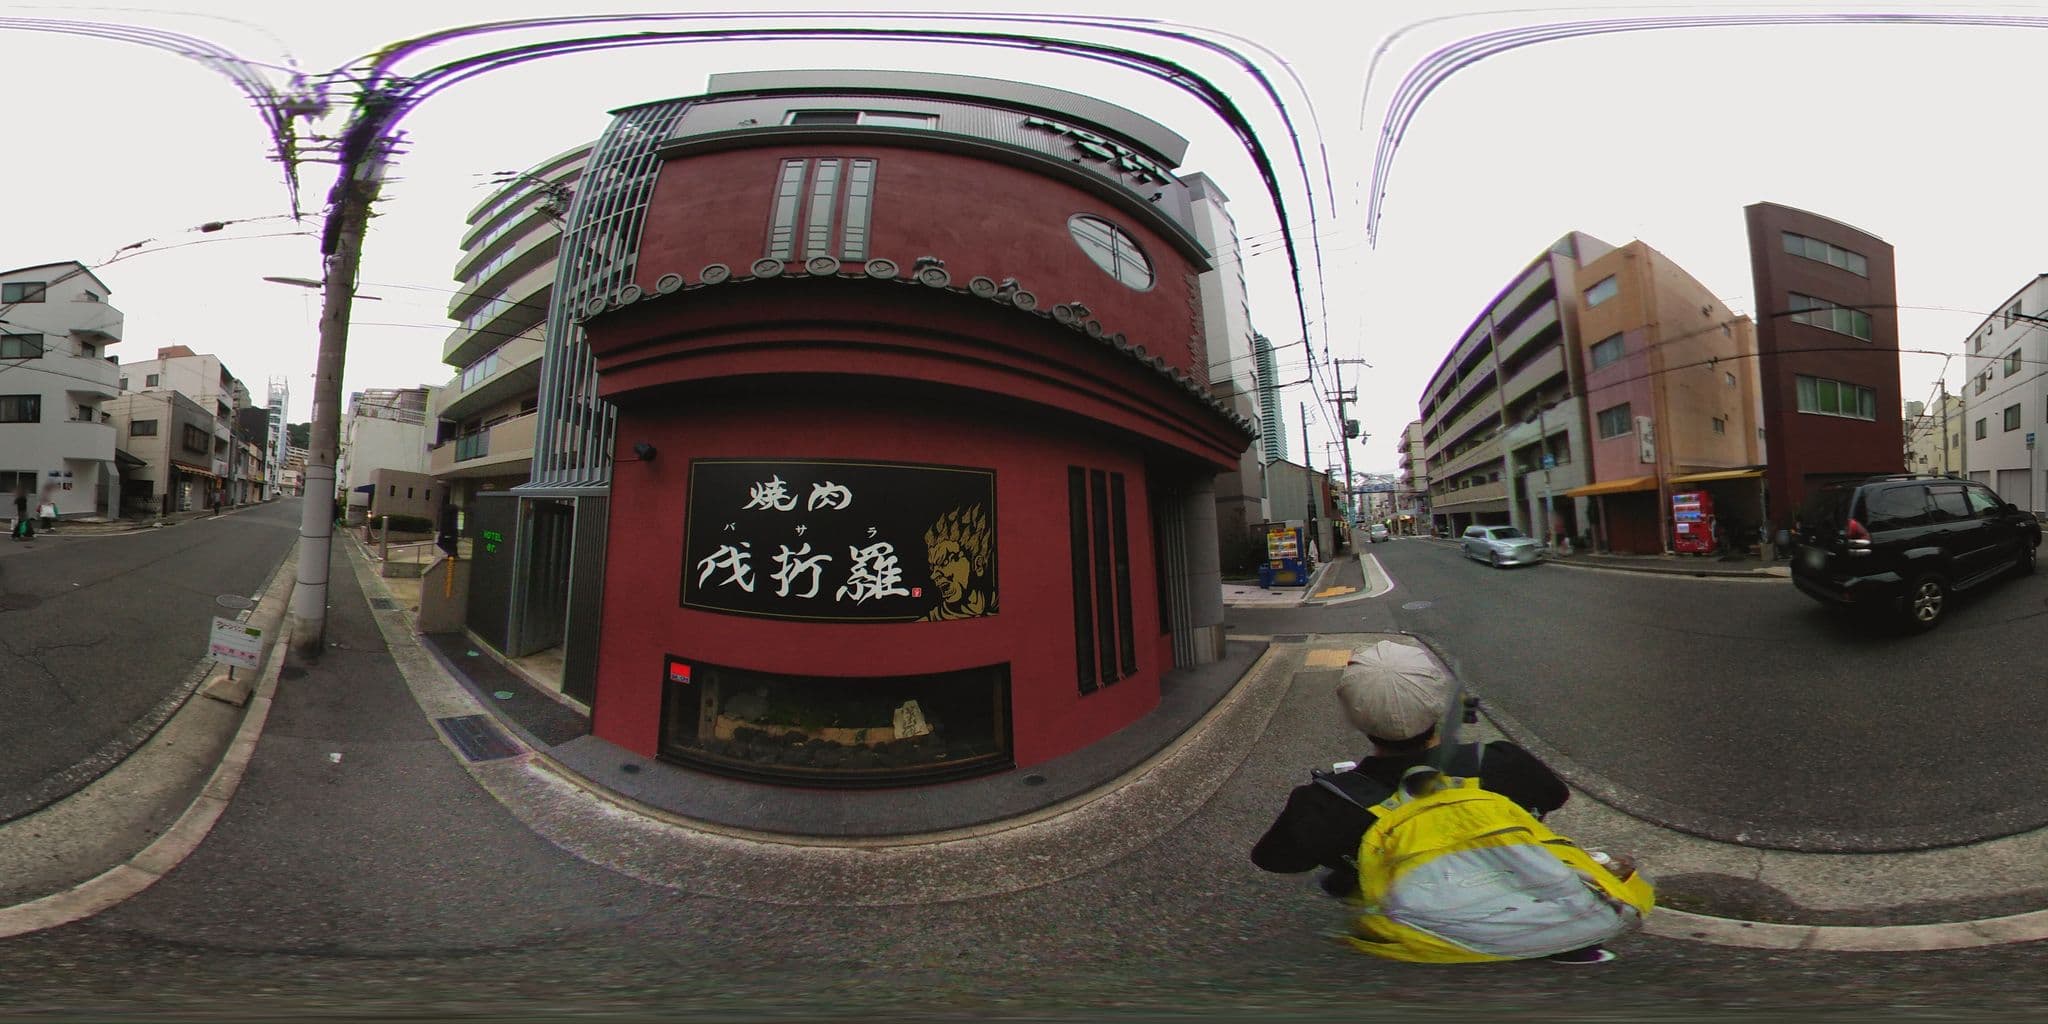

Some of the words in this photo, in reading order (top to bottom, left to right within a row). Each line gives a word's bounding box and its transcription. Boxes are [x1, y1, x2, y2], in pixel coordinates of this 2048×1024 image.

[1025, 115, 1172, 184] HOTEL
[741, 474, 853, 512] 焼肉
[696, 541, 910, 606] 伐折羅
